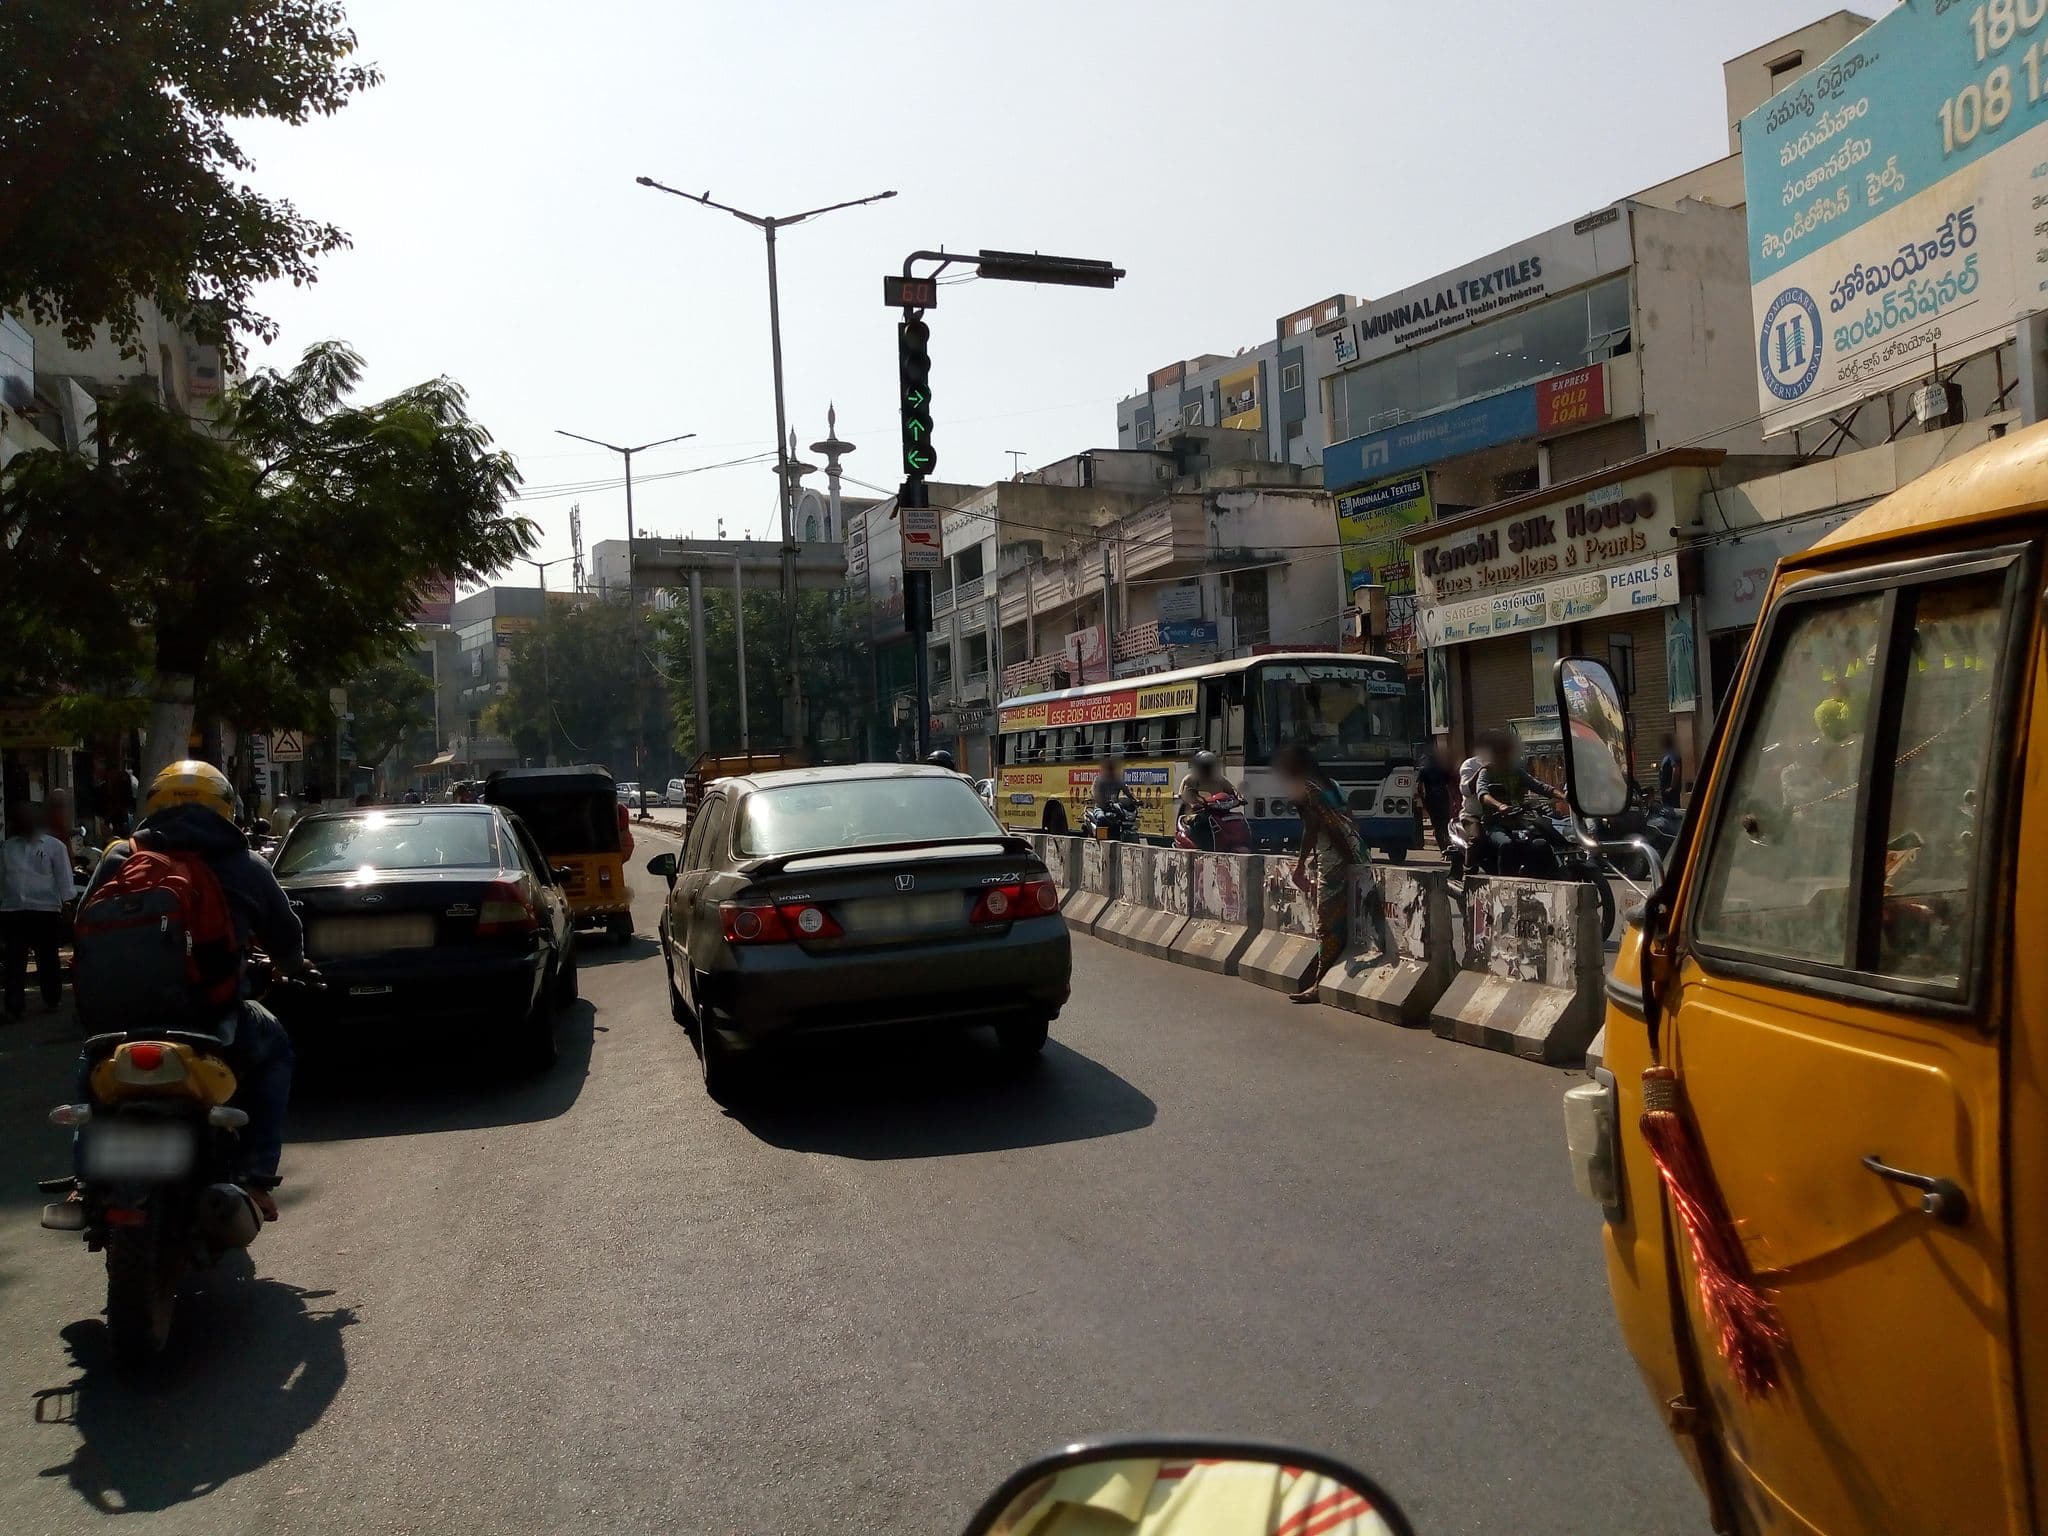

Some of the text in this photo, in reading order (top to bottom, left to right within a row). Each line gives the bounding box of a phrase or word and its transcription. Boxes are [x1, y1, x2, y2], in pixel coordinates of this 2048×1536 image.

[1937, 64, 2013, 155] 108
[1361, 256, 1543, 342] MUNNALAL TEXTILES
[1763, 290, 1815, 335] HOMEOCARE
[1394, 318, 1439, 345] International
[1551, 372, 1590, 392] EXPRESS
[1762, 344, 1822, 398] INTERNATIONAL
[1552, 388, 1587, 409] GOLD
[1551, 402, 1588, 424] LOAN
[1352, 481, 1421, 508] MUNNALAL TEXTILES
[1422, 530, 1499, 577] Kanchi
[1508, 514, 1557, 554] Silk
[1476, 552, 1558, 588] Jewellers
[1564, 543, 1578, 568] &
[1583, 528, 1646, 564] Pearls
[1444, 603, 1488, 622] SAREES
[1552, 576, 1601, 602] SILVER
[1610, 566, 1659, 589] PEARLS
[1663, 563, 1673, 578] &
[1631, 589, 1658, 605] Gems
[1190, 627, 1205, 638] 4G
[1027, 705, 1046, 718] EASY
[1051, 709, 1066, 724] ESE
[1066, 707, 1084, 723] 2019
[1090, 704, 1111, 720] GATE
[1111, 702, 1132, 718] 2019
[1139, 690, 1176, 711] ADMISSION
[1176, 687, 1194, 706] OPEN
[1535, 704, 1559, 715] DISCOUNT
[1026, 773, 1043, 785] EASY
[1001, 872, 1020, 882] ZX
[777, 893, 811, 902] HONDA
